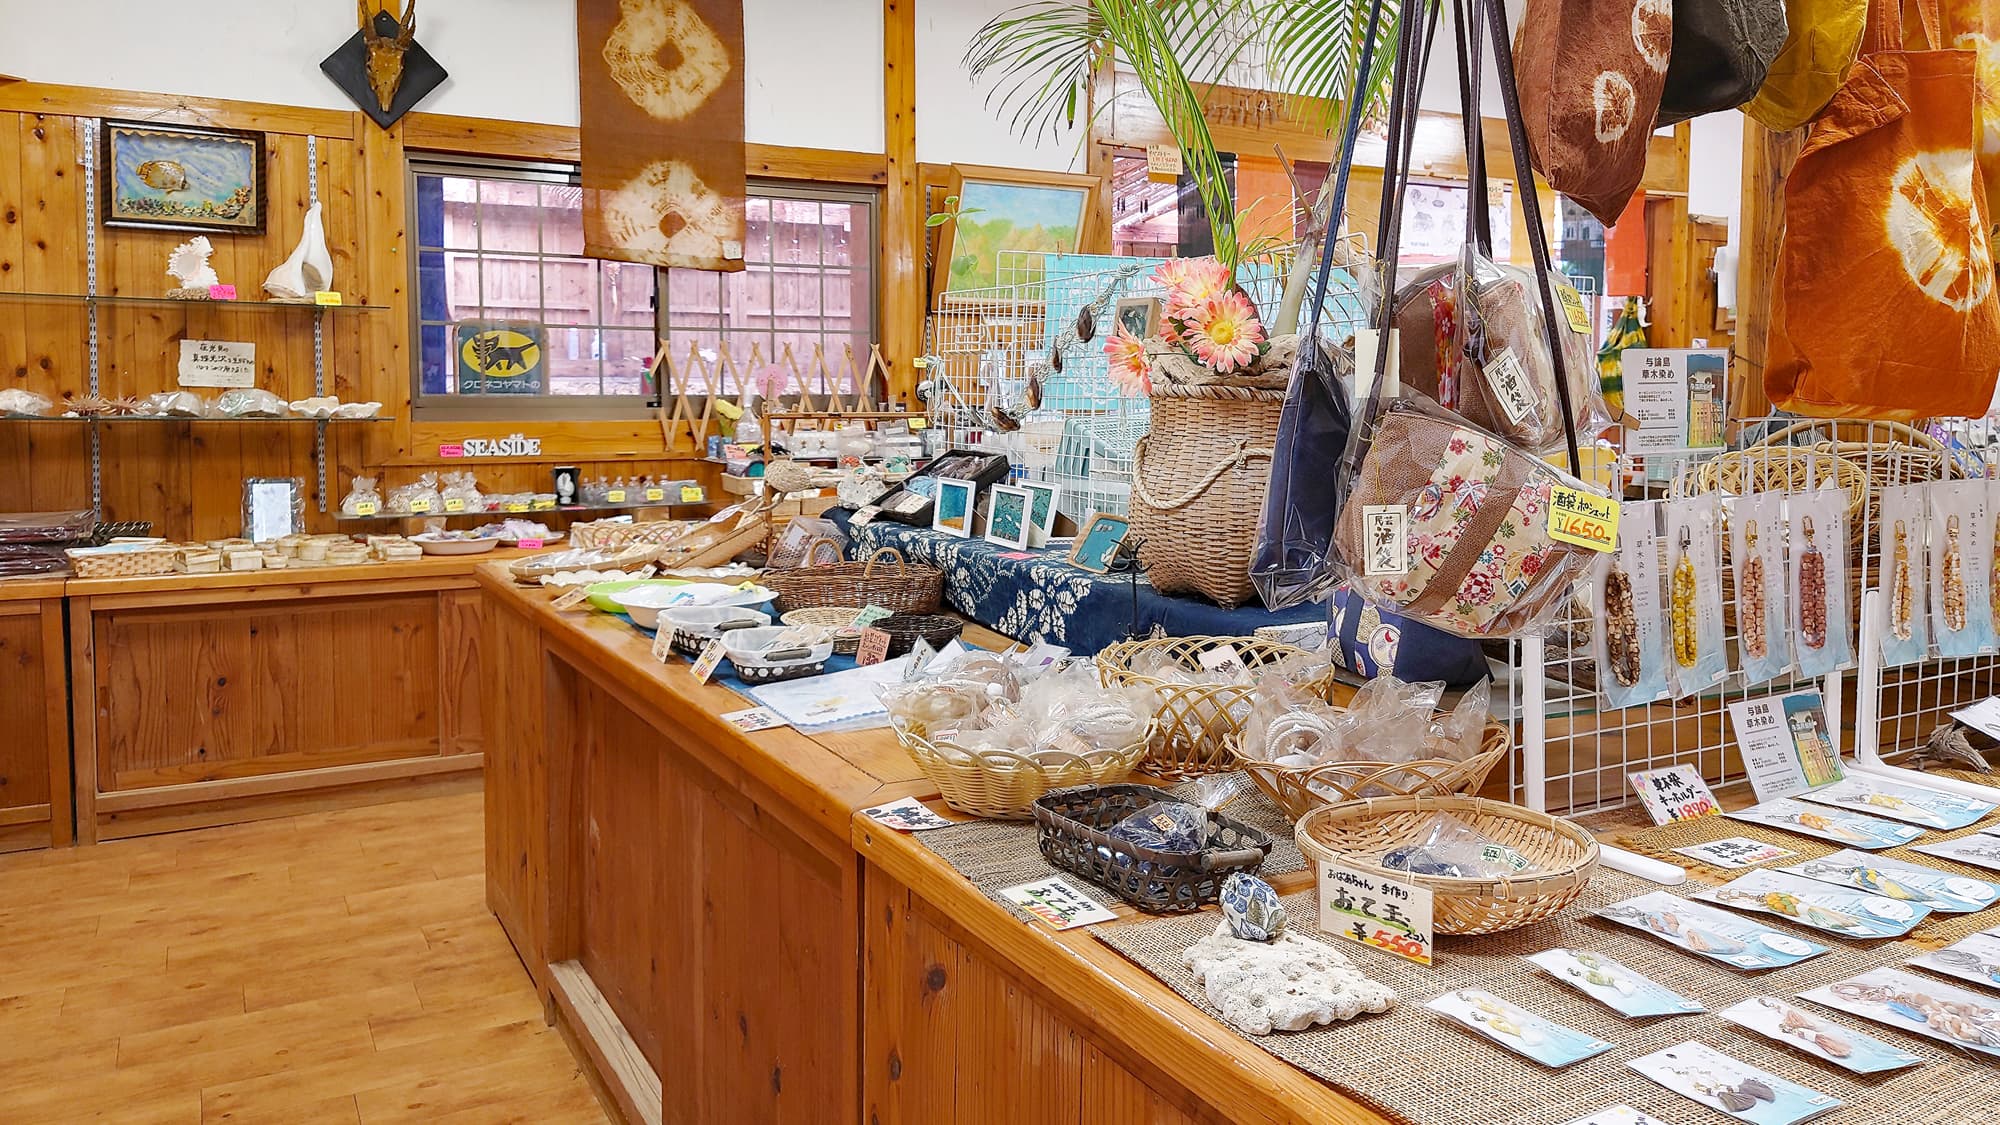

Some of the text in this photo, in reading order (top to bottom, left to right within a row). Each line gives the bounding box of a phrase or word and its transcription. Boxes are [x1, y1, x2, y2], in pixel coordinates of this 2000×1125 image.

[1645, 357, 1671, 367] 与論島
[1641, 370, 1675, 380] 草木染め
[463, 380, 541, 390] クロネコヤマトの
[1500, 373, 1530, 413] 酒袋
[463, 438, 541, 457] SEASIDE
[1375, 515, 1394, 526] 民芸
[1373, 526, 1396, 569] 酒袋
[1747, 703, 1769, 716] 与論島
[1746, 715, 1775, 729] 草木染め
[1652, 772, 1685, 792] 草木染
[1659, 785, 1706, 806] キーホルダー
[1327, 868, 1409, 900] おばあちゃん 手作り
[1332, 886, 1412, 927] おて玉
